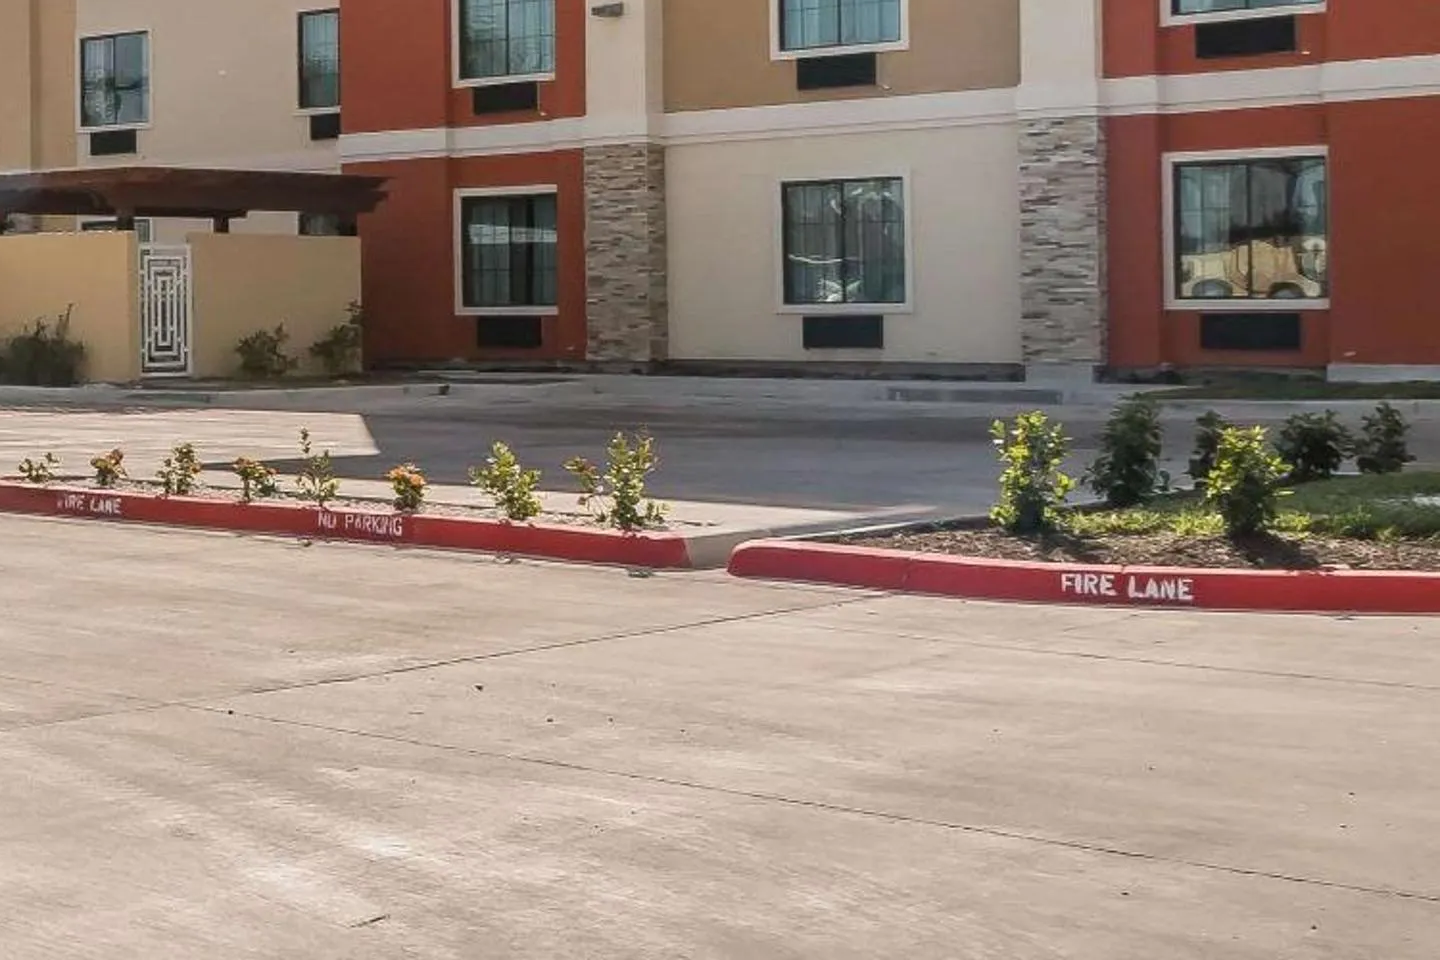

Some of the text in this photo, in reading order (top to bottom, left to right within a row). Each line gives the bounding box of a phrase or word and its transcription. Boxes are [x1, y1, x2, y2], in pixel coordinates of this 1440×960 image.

[344, 513, 403, 537] PARKING
[1061, 573, 1194, 601] FIRE LANE
